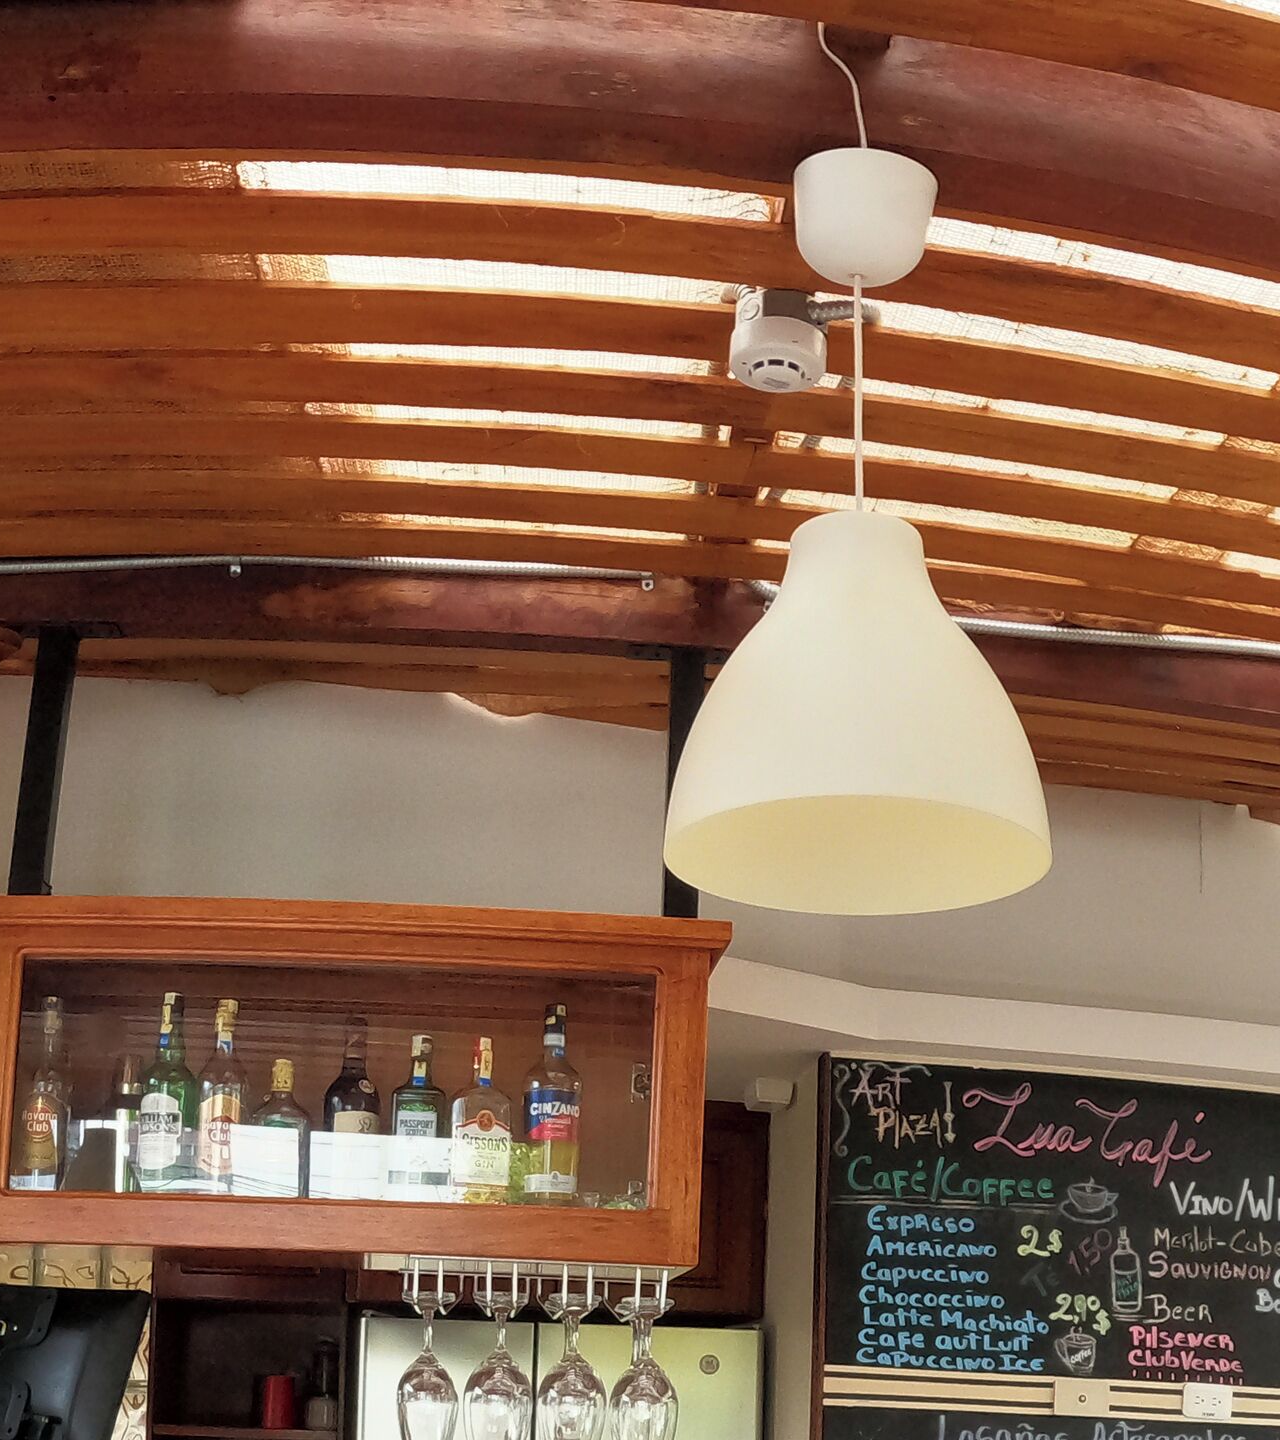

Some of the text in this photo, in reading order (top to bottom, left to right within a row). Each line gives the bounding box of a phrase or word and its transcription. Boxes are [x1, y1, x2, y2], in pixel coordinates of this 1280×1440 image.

[530, 1101, 580, 1118] CINZANO
[27, 1121, 49, 1132] Club
[400, 1119, 434, 1130] PASSPORT
